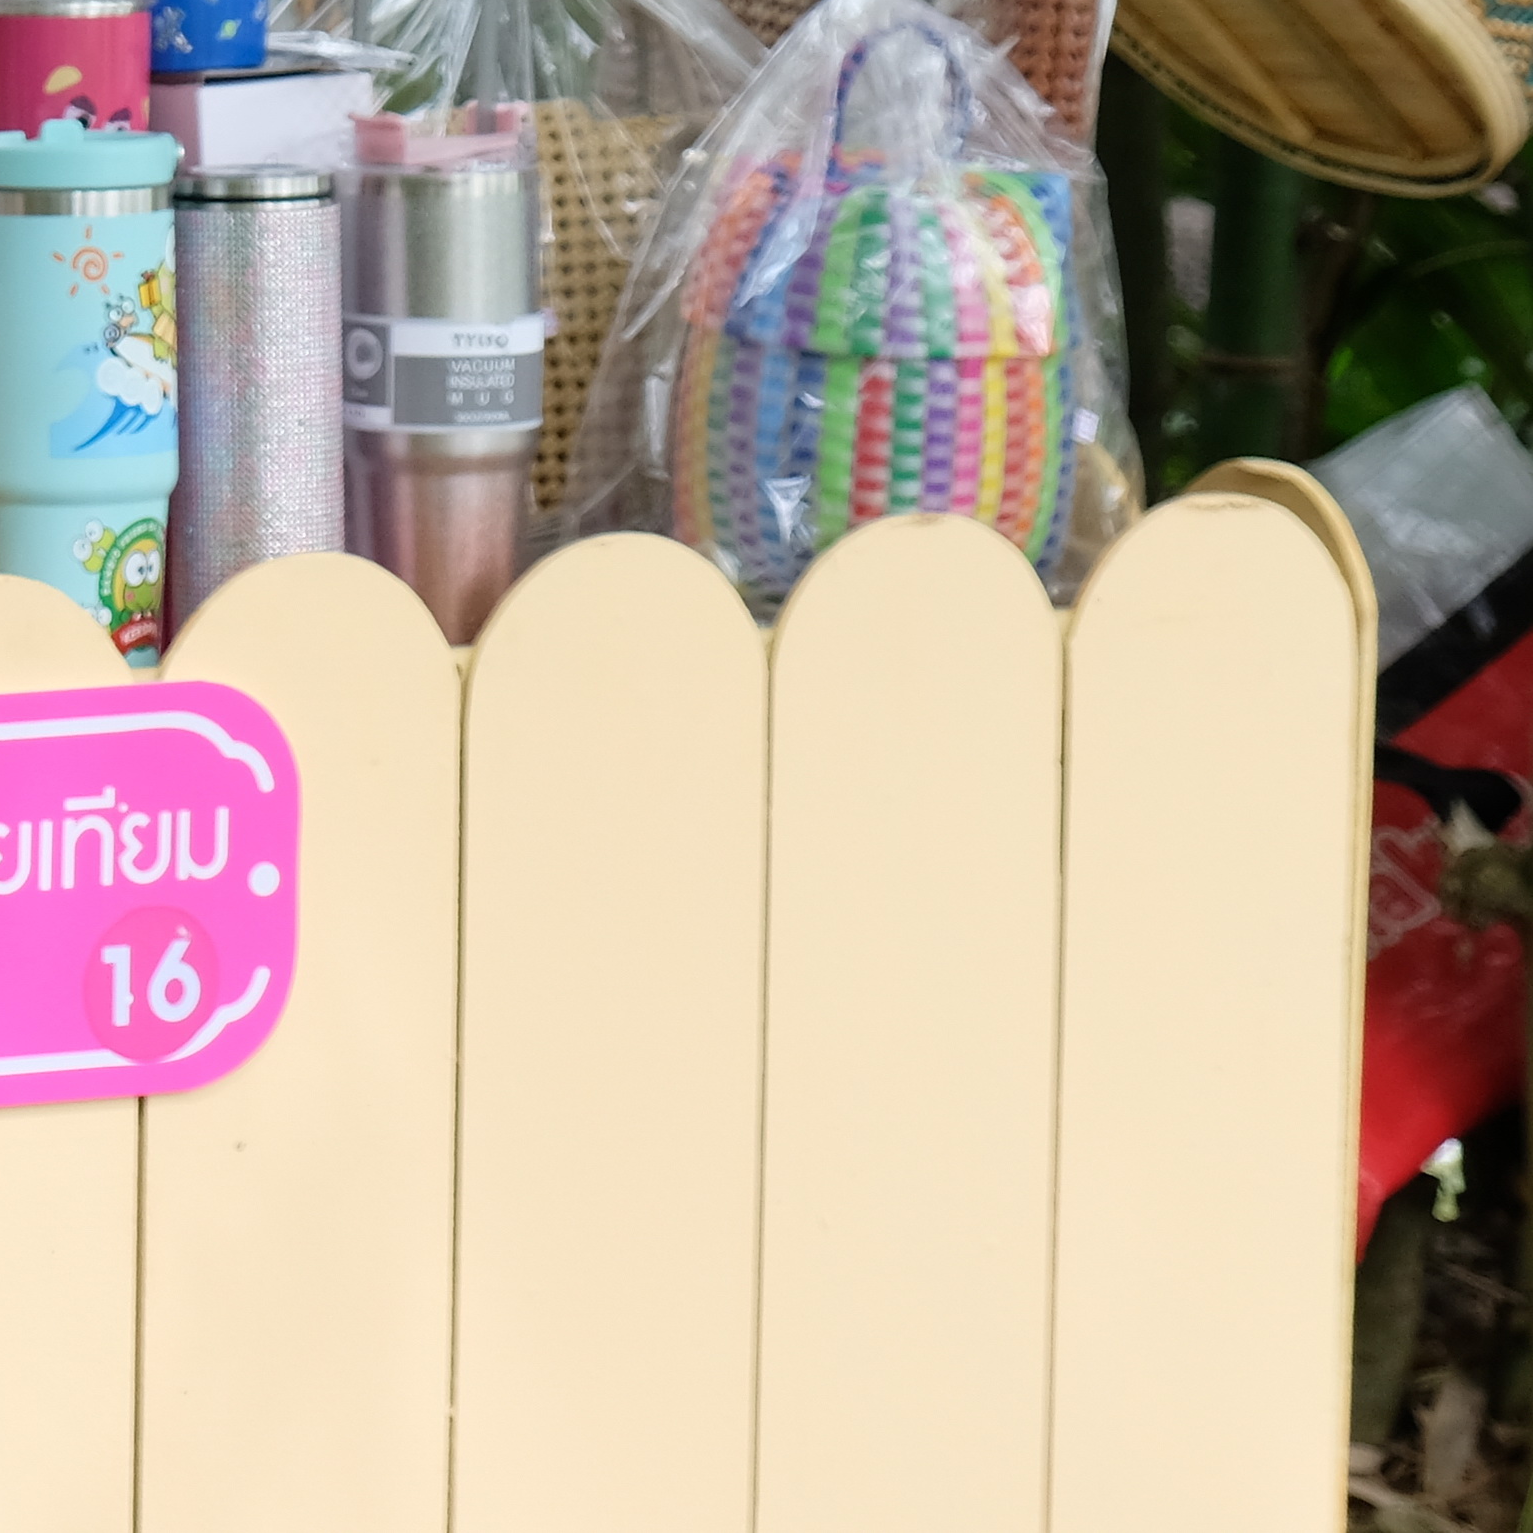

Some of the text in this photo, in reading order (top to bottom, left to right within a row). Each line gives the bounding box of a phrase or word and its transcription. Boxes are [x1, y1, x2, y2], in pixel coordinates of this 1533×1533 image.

[451, 358, 516, 373] VACUUM
[449, 390, 515, 405] MUG
[101, 936, 201, 1027] 16
